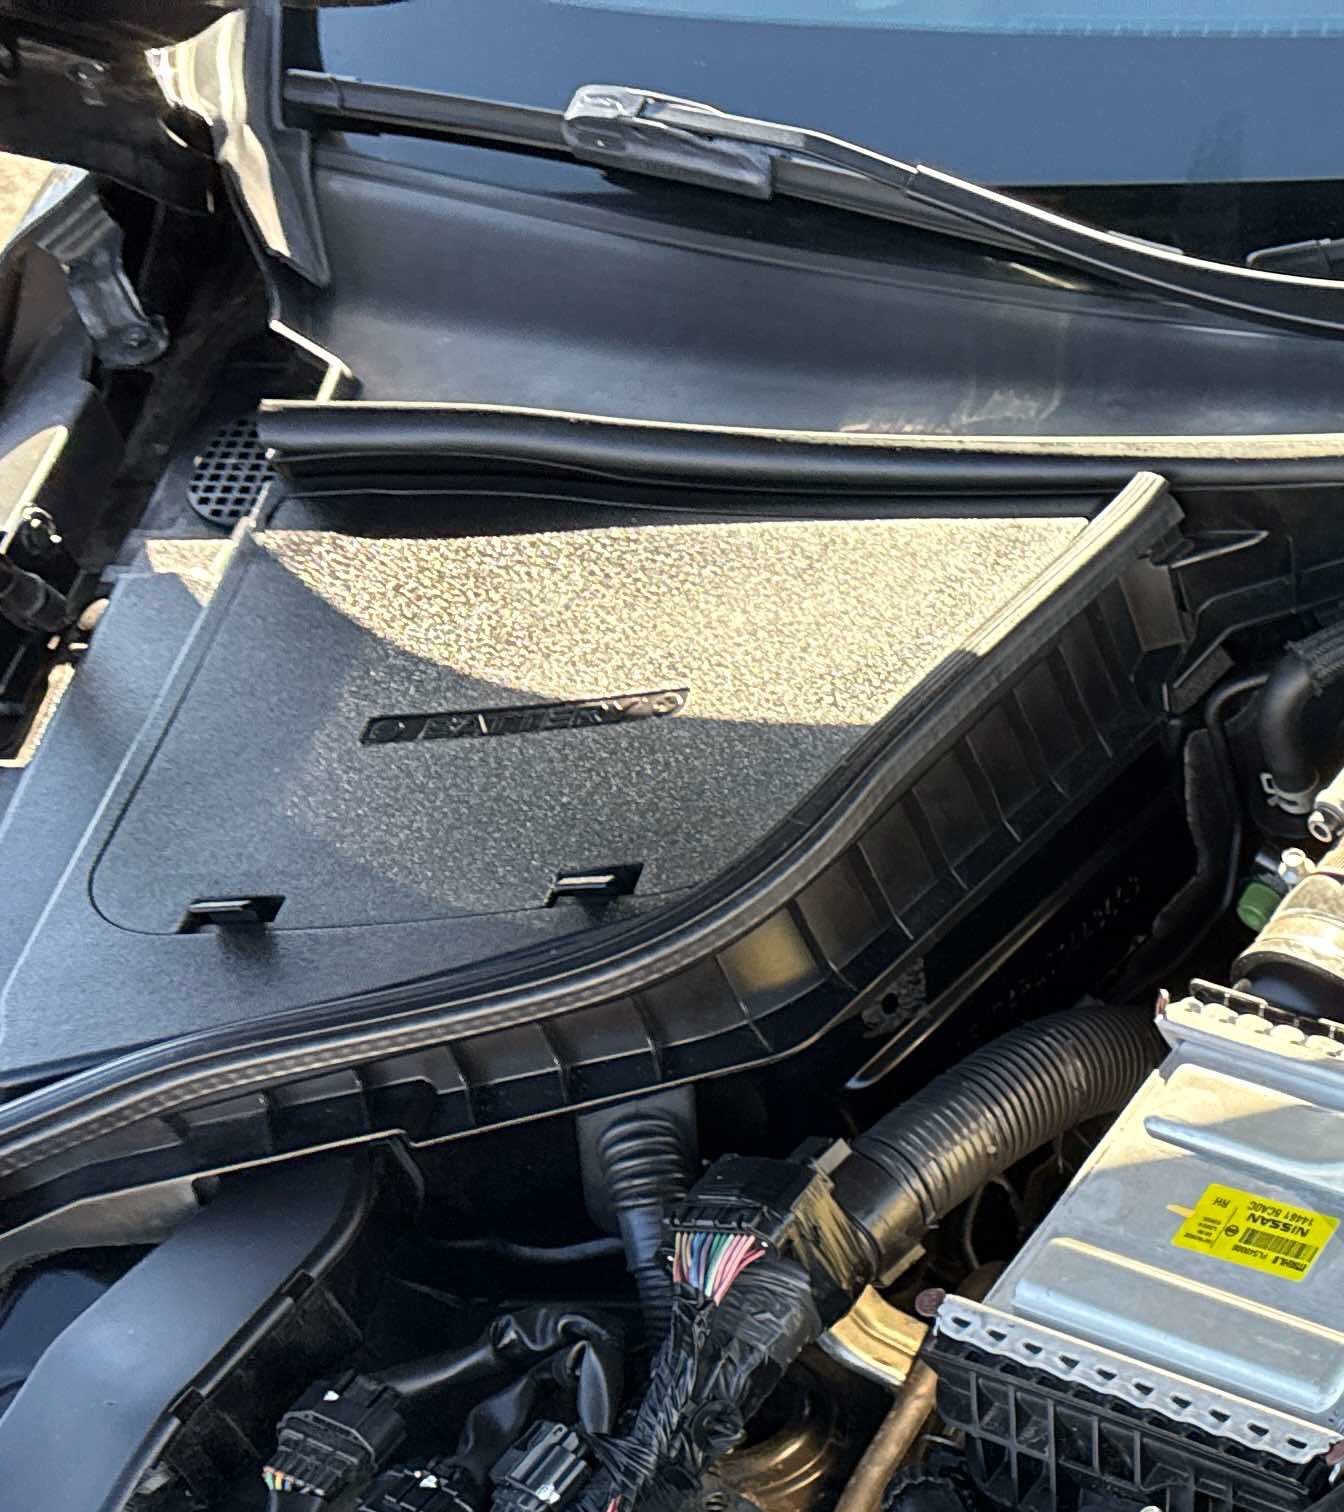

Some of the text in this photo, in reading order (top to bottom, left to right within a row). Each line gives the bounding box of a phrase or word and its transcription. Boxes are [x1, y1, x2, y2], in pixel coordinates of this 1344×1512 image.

[1213, 1196, 1231, 1208] RH
[1246, 1213, 1310, 1237] NISSAN
[1281, 1210, 1315, 1226] 14461
